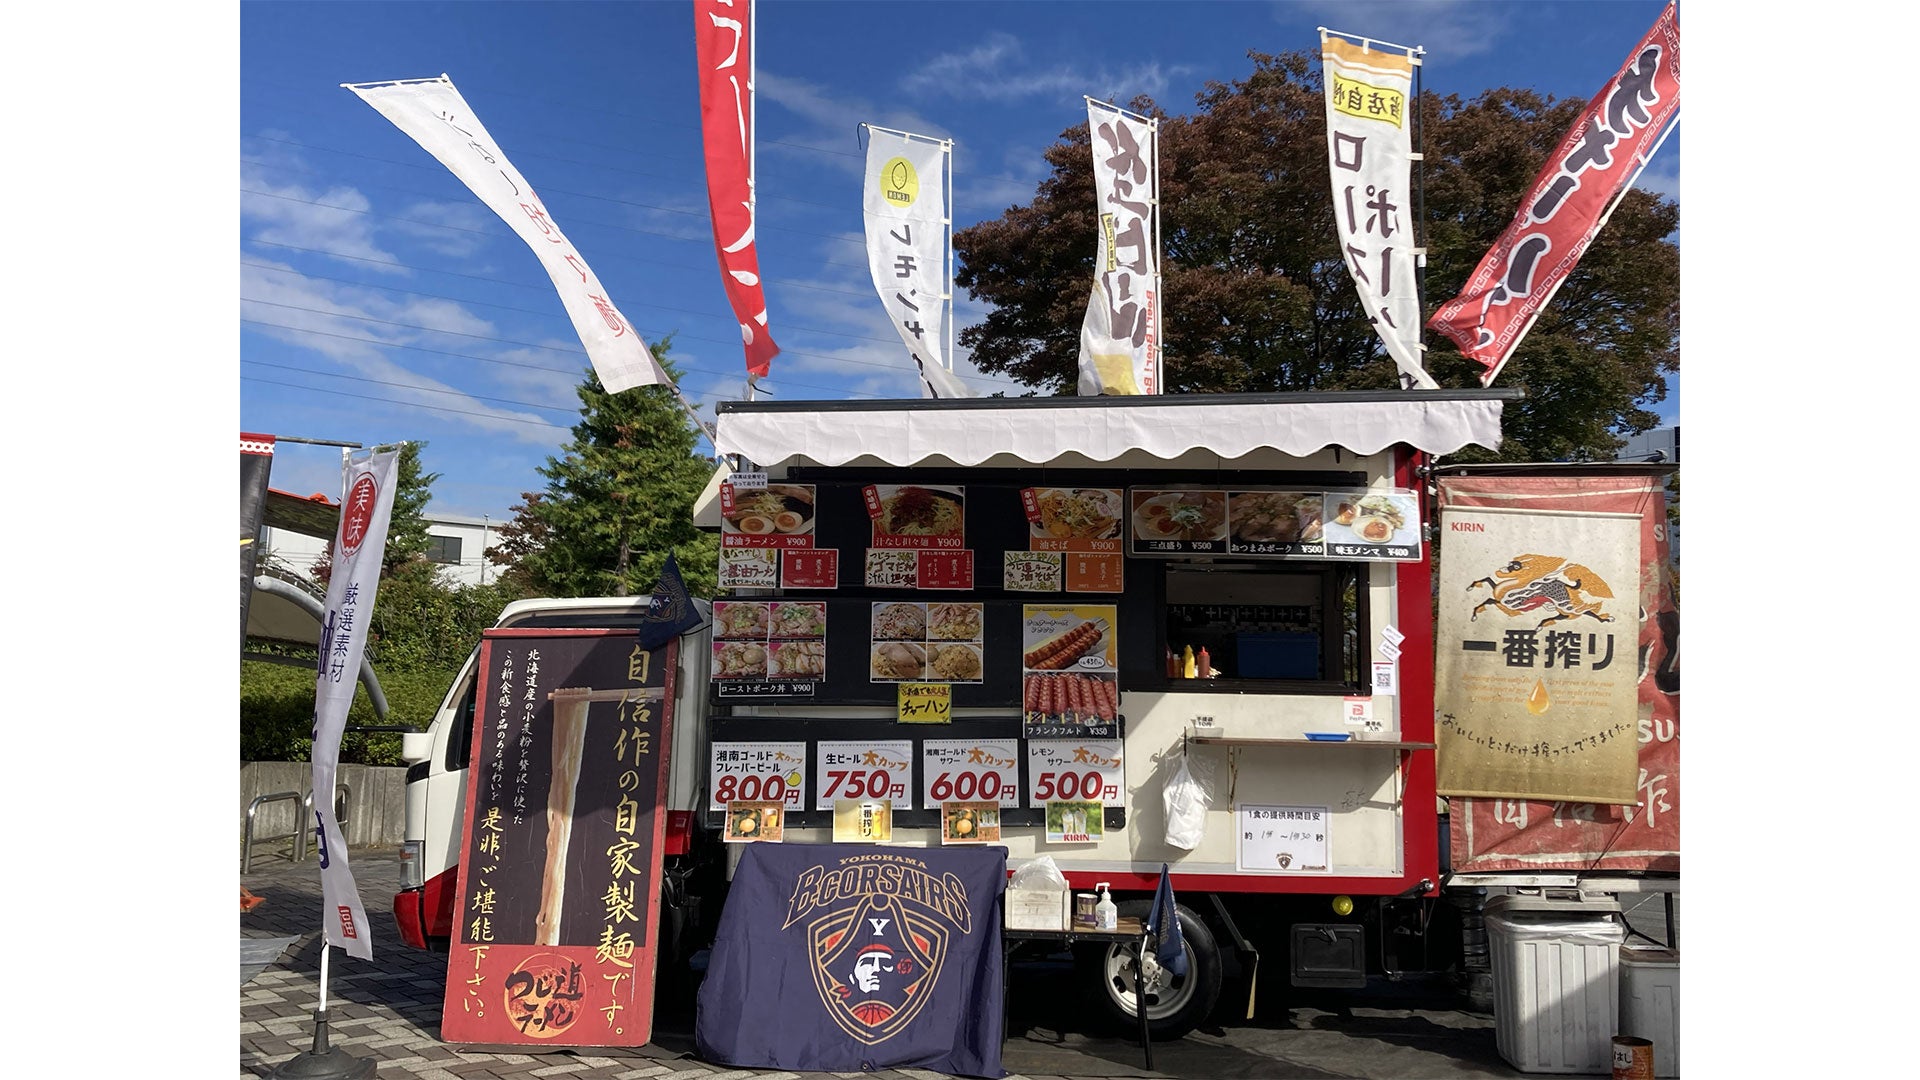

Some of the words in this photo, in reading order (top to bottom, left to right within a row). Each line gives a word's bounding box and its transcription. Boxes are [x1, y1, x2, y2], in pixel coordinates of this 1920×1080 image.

[346, 479, 372, 545] 美味
[1451, 521, 1485, 533] KIRIN
[786, 537, 806, 546] ¥900
[937, 538, 961, 548] ¥900
[1039, 540, 1069, 551] 油そば
[1090, 541, 1115, 550] ¥900
[1149, 541, 1183, 551] 三点盛り
[1192, 541, 1212, 551] ¥500
[1231, 544, 1293, 555] おつまみポーク
[1302, 545, 1323, 555] ¥500
[1387, 547, 1410, 557] ¥400
[328, 581, 360, 684] 厳選素材
[1462, 629, 1615, 671] 一番搾り
[721, 684, 786, 694] ローストポーク丼
[792, 683, 812, 693] ¥900
[901, 699, 950, 716] チャーハン
[1027, 726, 1082, 736] フランクフルト
[1089, 726, 1109, 736] ¥350
[716, 750, 775, 762] 湘南ゴールド
[774, 750, 804, 765] 大カップ
[825, 753, 862, 765] 生ビール
[862, 750, 910, 772] 大カップ
[925, 748, 967, 757] 湘南ゴールド
[967, 746, 1016, 769] 大カップ
[939, 757, 961, 766] サワー
[1031, 747, 1056, 757] レモン
[1072, 746, 1122, 769] 大カップ
[1047, 757, 1072, 767] サワー
[716, 762, 781, 774] フレーバービール
[715, 774, 801, 805] 800円
[823, 769, 906, 799] 750円
[930, 771, 1016, 801] 600円
[1034, 771, 1118, 801] 500円
[862, 804, 873, 837] 一番搾り
[1248, 810, 1321, 822] 1食の提供時間目安
[595, 644, 653, 1036] 自信作の自家製麺です。
[1063, 833, 1090, 842] KIRIN
[839, 854, 928, 869] YOKOHAMA
[463, 808, 505, 1019] 是非、ご堪能下さい。
[868, 918, 891, 937] Y
[504, 962, 584, 1003] つじ道
[516, 1002, 575, 1034] ラーメン
[1613, 1050, 1632, 1064] はし
